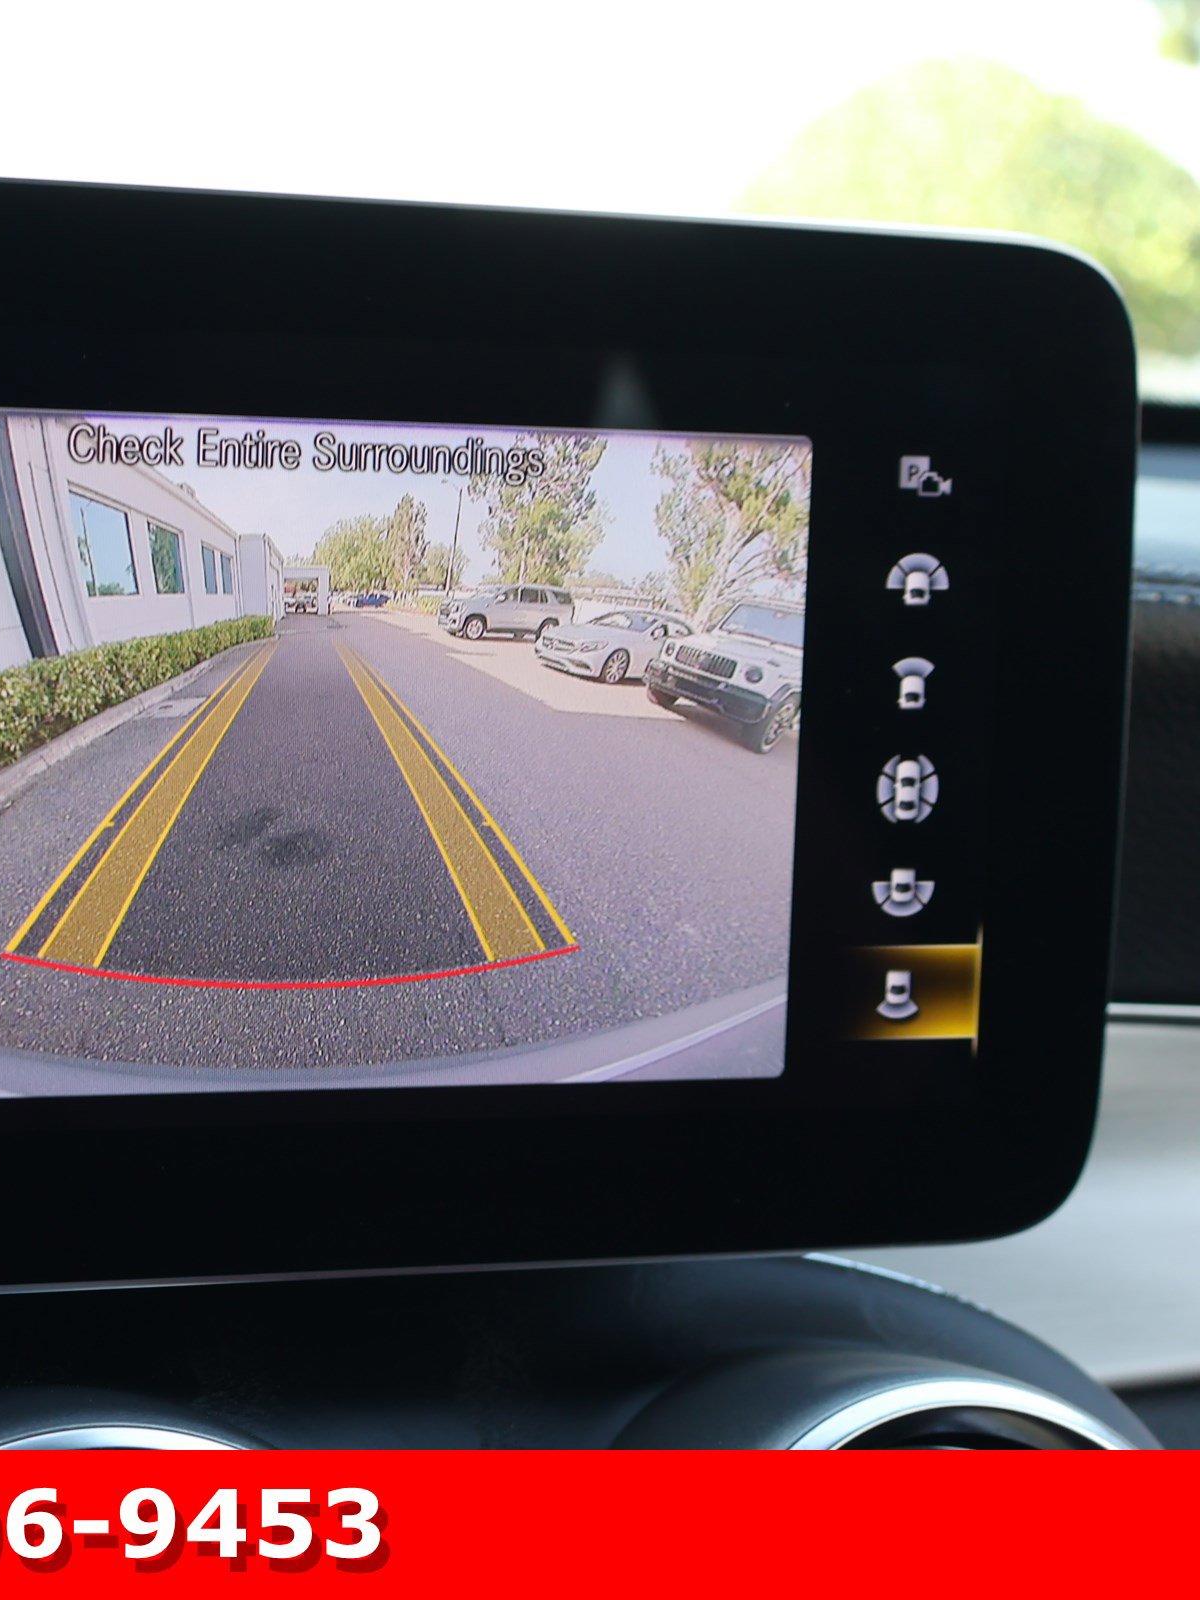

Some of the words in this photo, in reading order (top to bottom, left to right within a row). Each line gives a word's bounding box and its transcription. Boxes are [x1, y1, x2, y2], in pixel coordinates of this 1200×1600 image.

[67, 422, 184, 466] Check
[198, 427, 302, 470] Entire
[312, 431, 545, 486] Surroundings
